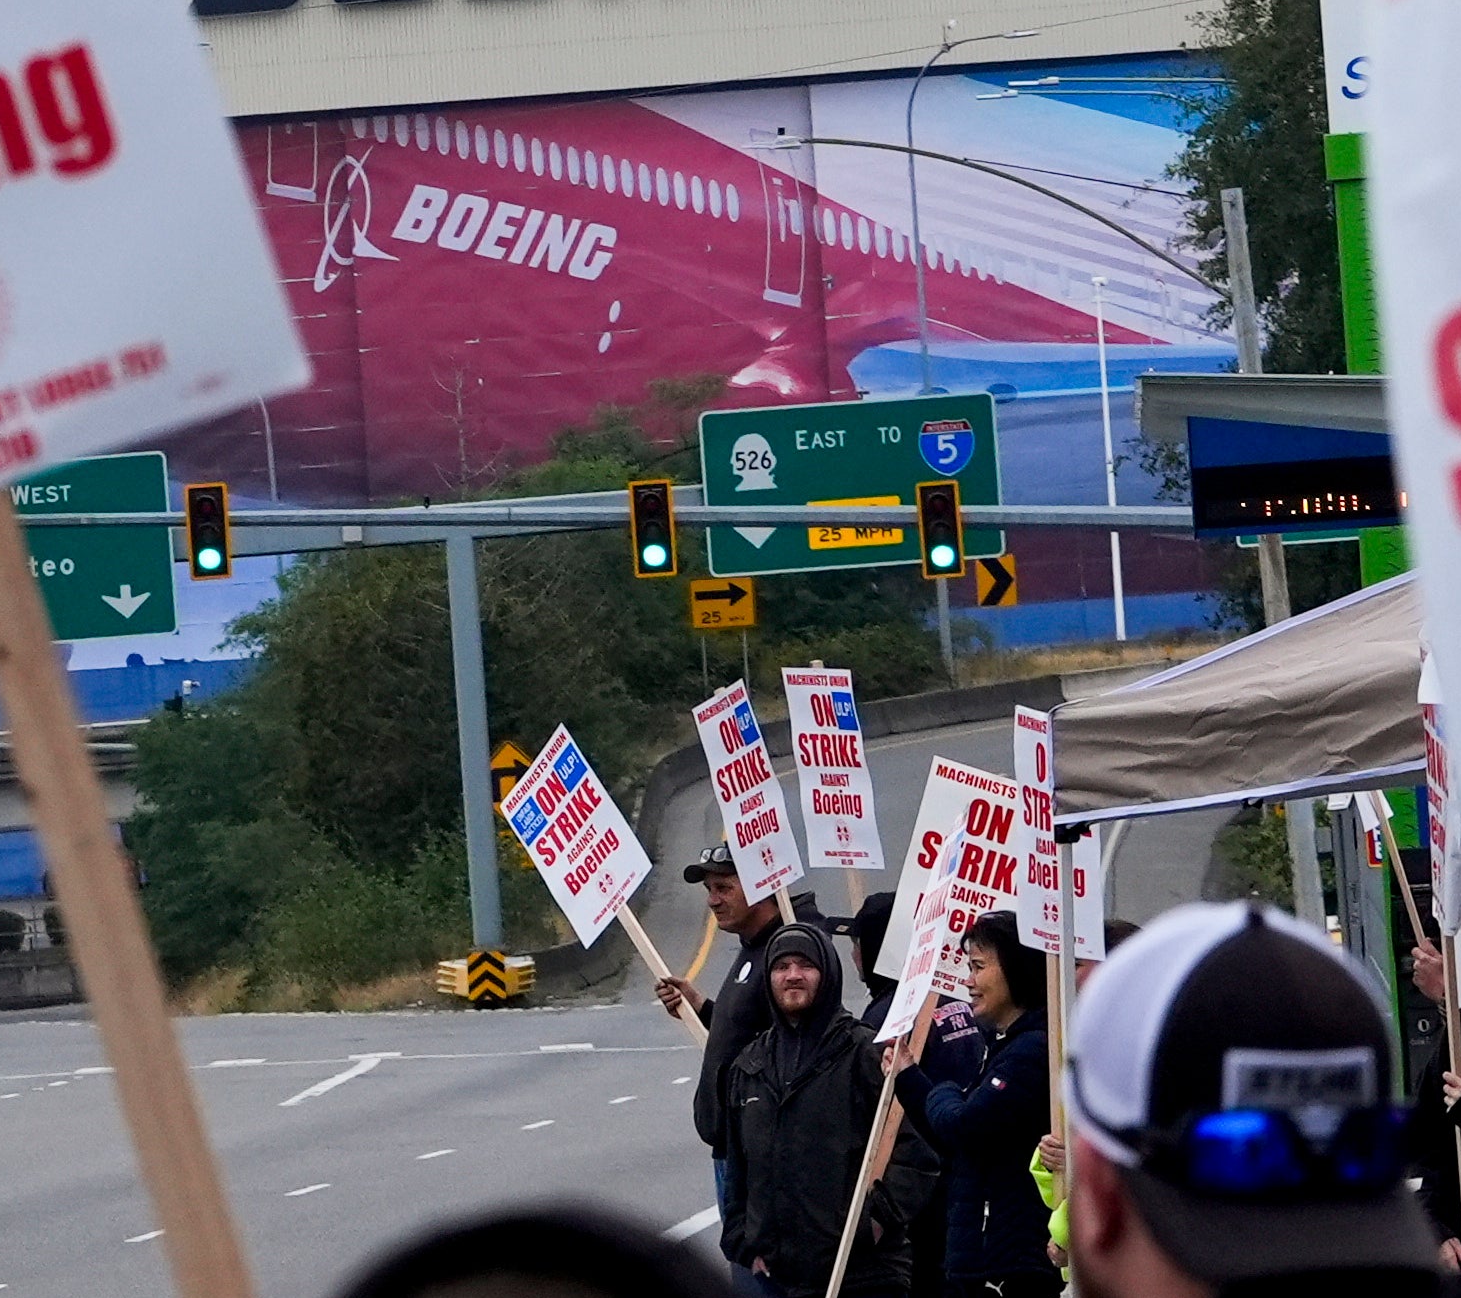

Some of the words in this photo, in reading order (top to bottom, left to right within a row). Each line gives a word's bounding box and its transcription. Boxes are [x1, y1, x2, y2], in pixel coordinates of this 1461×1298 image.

[392, 182, 618, 282] BOEING
[795, 430, 847, 450] EAST
[878, 426, 902, 444] TO
[937, 434, 959, 465] 5
[735, 451, 772, 471] 526
[11, 484, 72, 505] WEST
[819, 528, 843, 543] 25
[855, 527, 894, 541] MPH
[701, 611, 722, 625] 25
[810, 693, 837, 727] ON
[719, 714, 745, 755] ON
[798, 732, 862, 768] STRIKE
[505, 758, 549, 813] MACHINISTS
[544, 731, 567, 762] UNION
[716, 745, 772, 803] STRIKE
[935, 763, 1018, 799] MACHINISTS
[1036, 742, 1047, 783] O
[535, 770, 568, 816] ON
[558, 751, 581, 781] ULP!
[812, 788, 863, 819] Boeing
[534, 777, 602, 868] STRIKE
[735, 807, 780, 849] Boeing
[966, 798, 1015, 845] ON
[563, 827, 620, 896] Boeing
[566, 823, 598, 865] AGAINST
[917, 830, 1018, 896] SRIK
[1028, 852, 1086, 898] Boeig
[950, 884, 997, 911] GAINST
